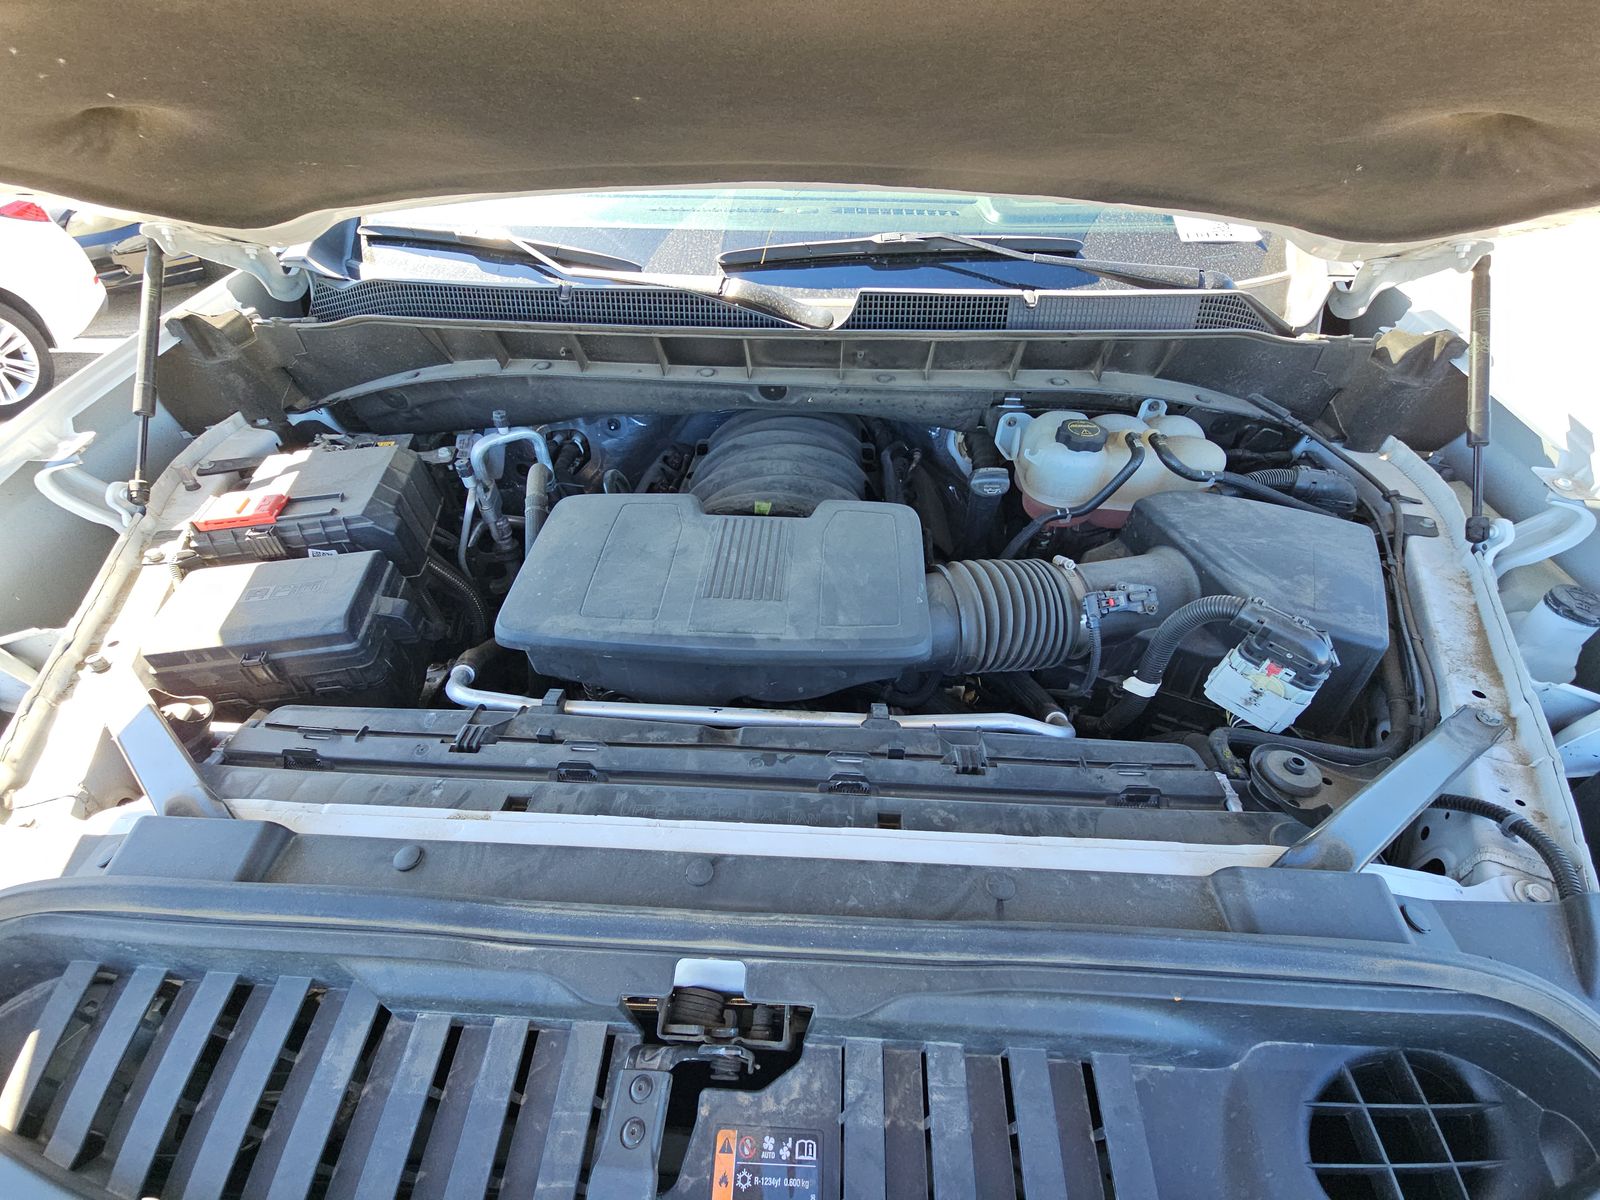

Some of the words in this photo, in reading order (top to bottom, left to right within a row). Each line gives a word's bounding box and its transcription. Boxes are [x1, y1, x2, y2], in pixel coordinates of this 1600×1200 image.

[621, 804, 676, 817] UPPER
[761, 1151, 776, 1160] AUTO
[754, 1176, 781, 1188] R-1234yf
[783, 1177, 801, 1188] 0.600
[801, 1178, 810, 1190] kg
